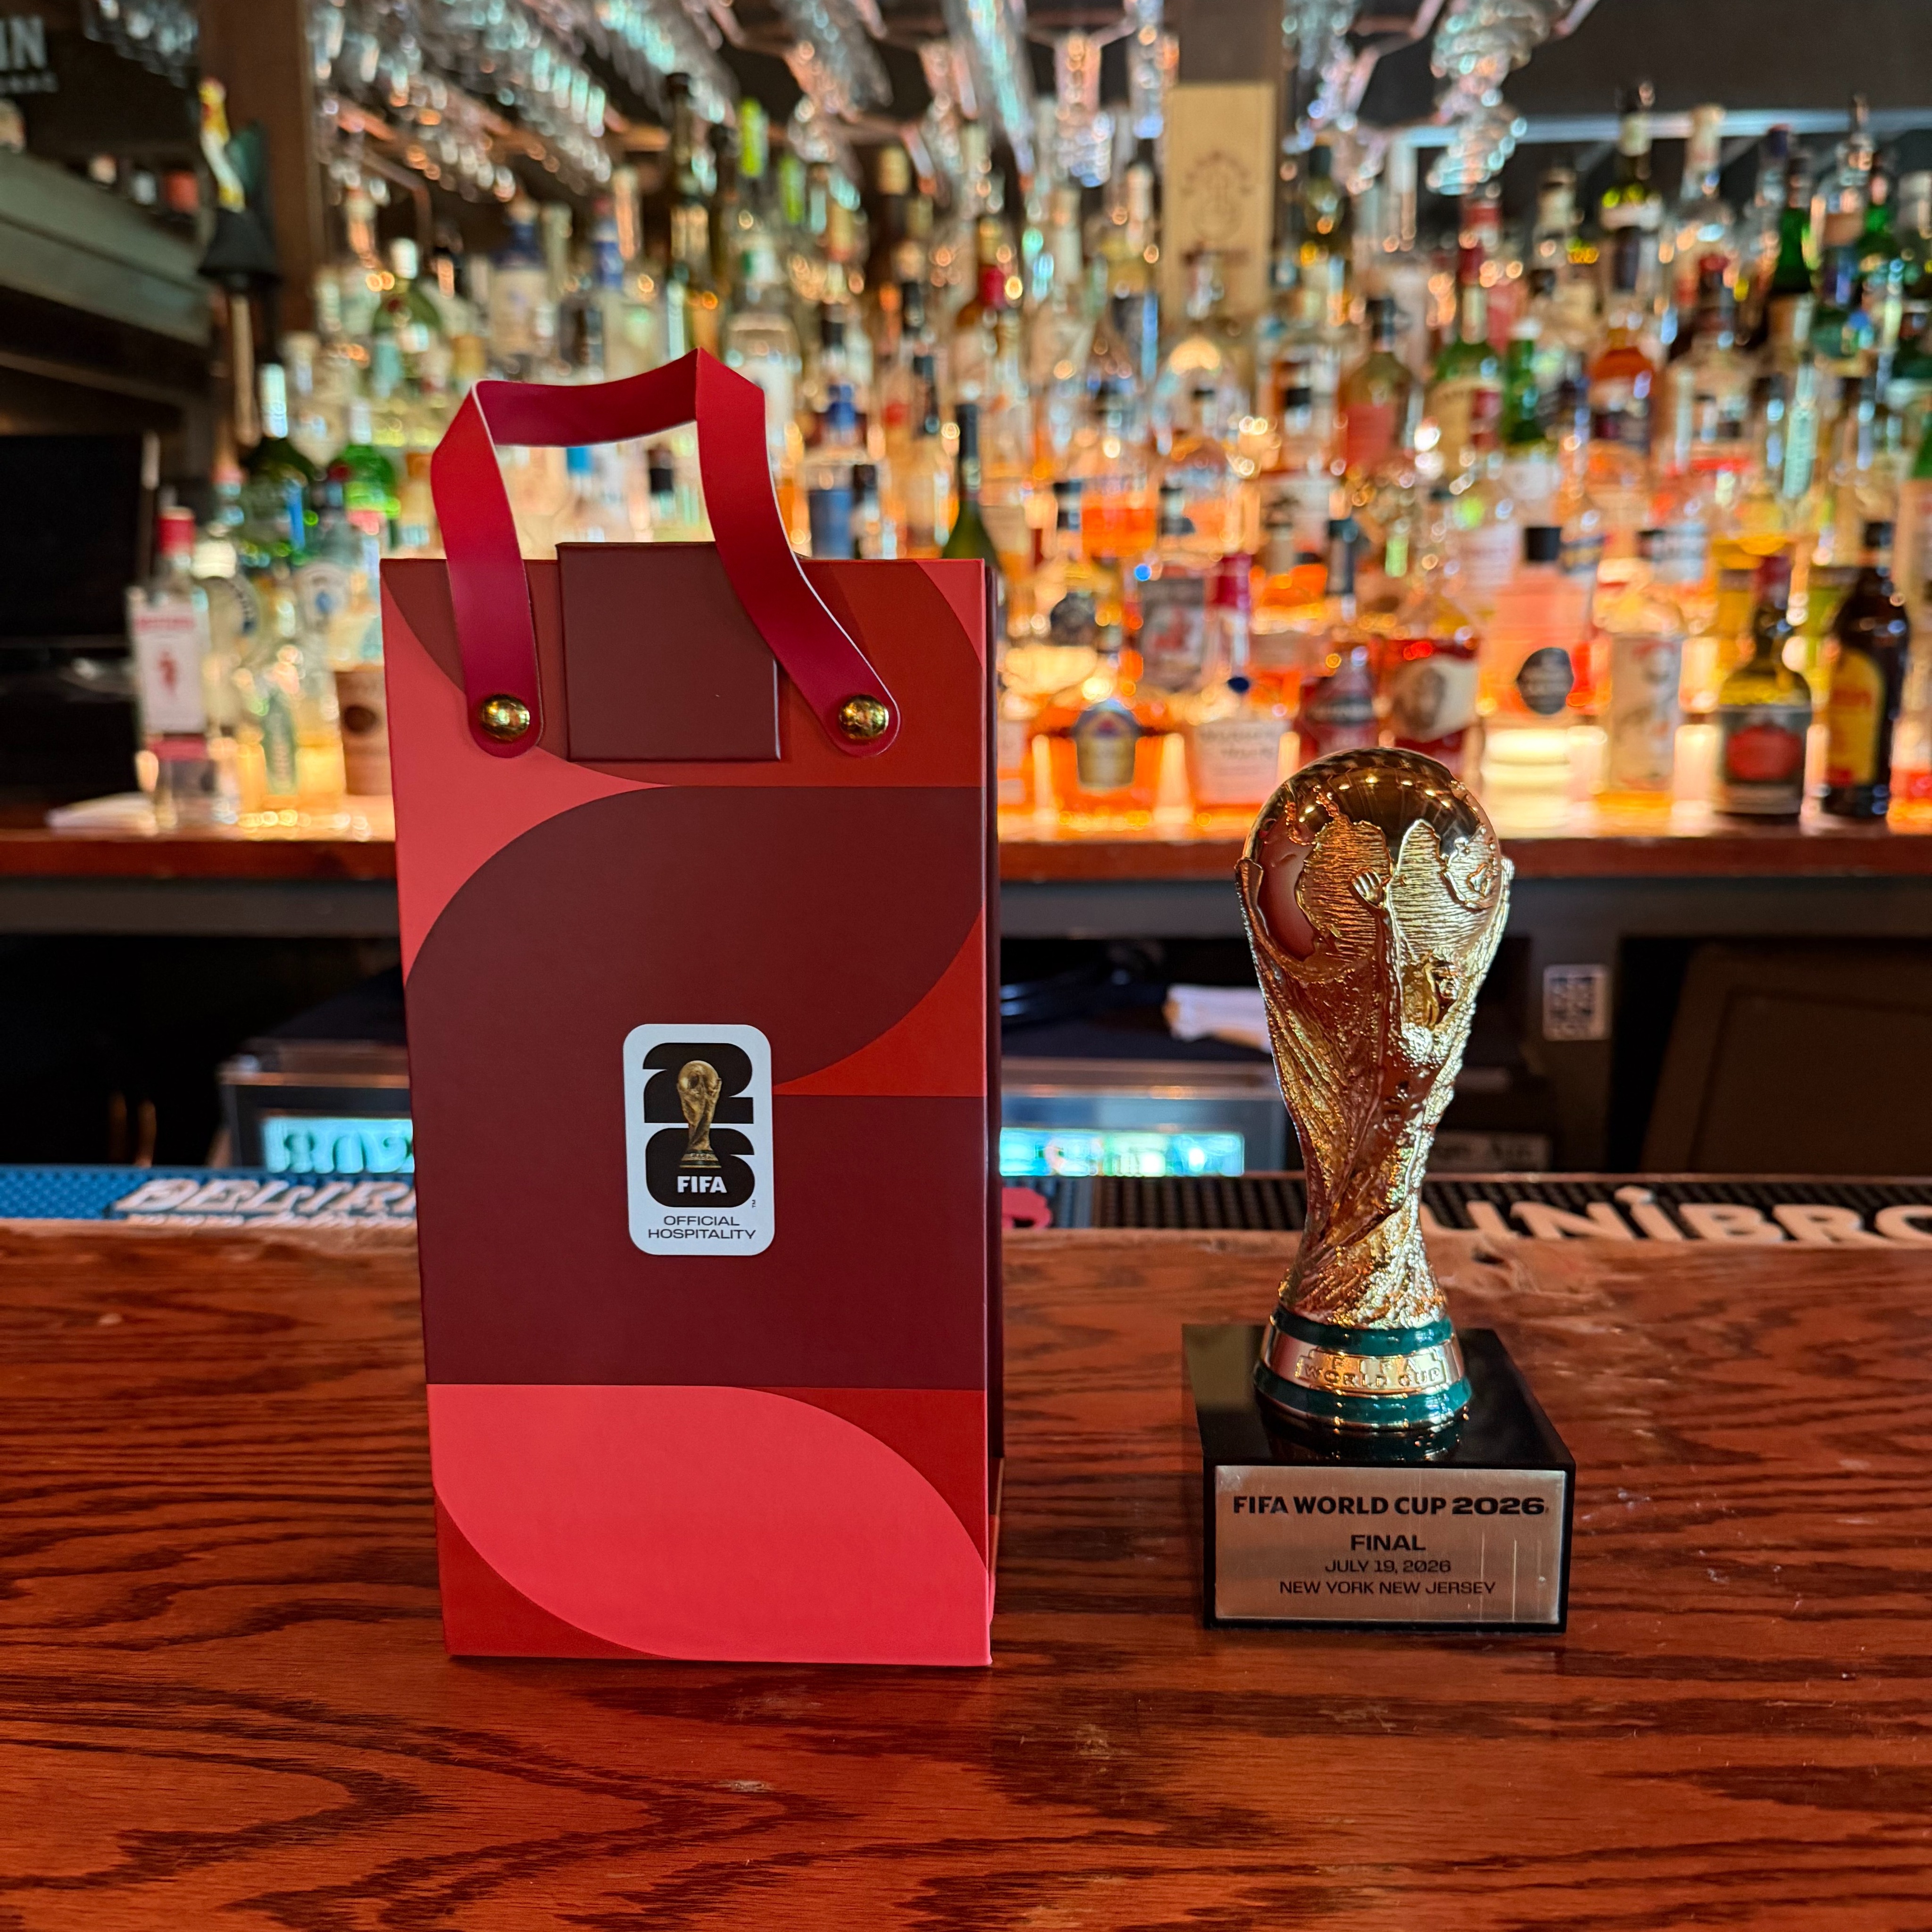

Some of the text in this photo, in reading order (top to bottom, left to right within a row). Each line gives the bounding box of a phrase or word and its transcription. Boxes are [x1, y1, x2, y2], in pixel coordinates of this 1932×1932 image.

[677, 1176, 727, 1193] FIFA
[664, 1216, 740, 1226] OFFICIAL
[648, 1229, 756, 1239] HOSPITALITY
[1233, 1496, 1544, 1515] FIFA WORLD CUP 2026
[1351, 1535, 1426, 1551] FINAL
[1324, 1559, 1451, 1574] JULY 19, 2026
[1280, 1581, 1496, 1594] NEW YORK NEW JERSEY
